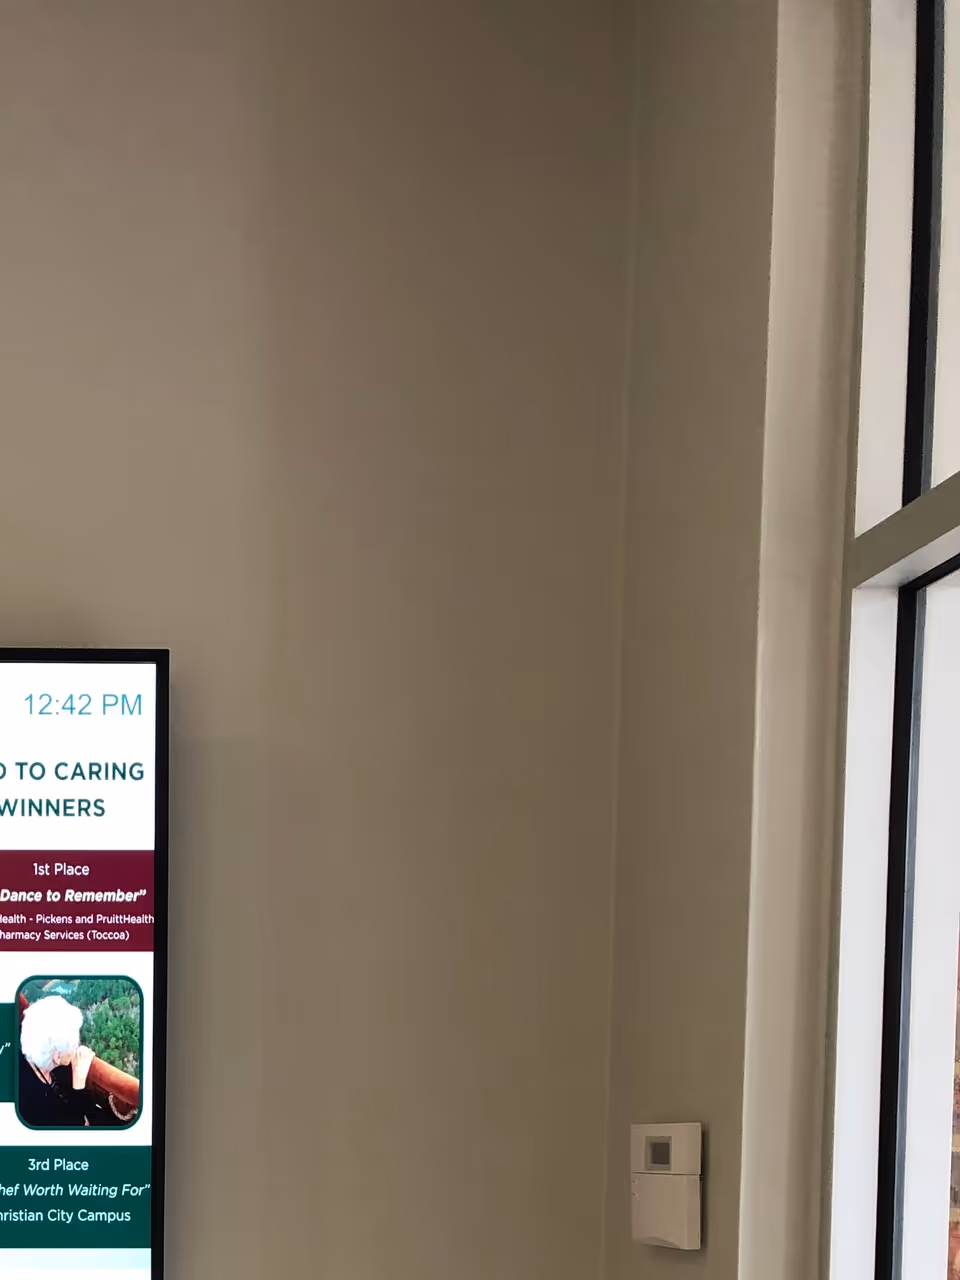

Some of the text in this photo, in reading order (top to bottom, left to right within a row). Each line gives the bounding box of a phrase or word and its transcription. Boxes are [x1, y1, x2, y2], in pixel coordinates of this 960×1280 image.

[24, 693, 143, 716] 12:42 PM
[15, 762, 46, 781] TO
[54, 762, 145, 781] CARING
[33, 862, 90, 876] 1st Place
[0, 889, 42, 902] Dance
[46, 890, 61, 902] to
[64, 889, 147, 903] Remember”
[36, 914, 73, 925] Pickens
[75, 914, 94, 925] and
[96, 914, 155, 925] PruittHealth
[43, 929, 84, 941] Services
[86, 929, 130, 941] (Toccoa)
[28, 1158, 89, 1172] 3rd Place
[23, 1183, 64, 1197] Worth
[67, 1183, 118, 1199] Waiting
[122, 1183, 151, 1197] For”
[47, 1208, 74, 1225] City
[77, 1208, 132, 1225] Campus
